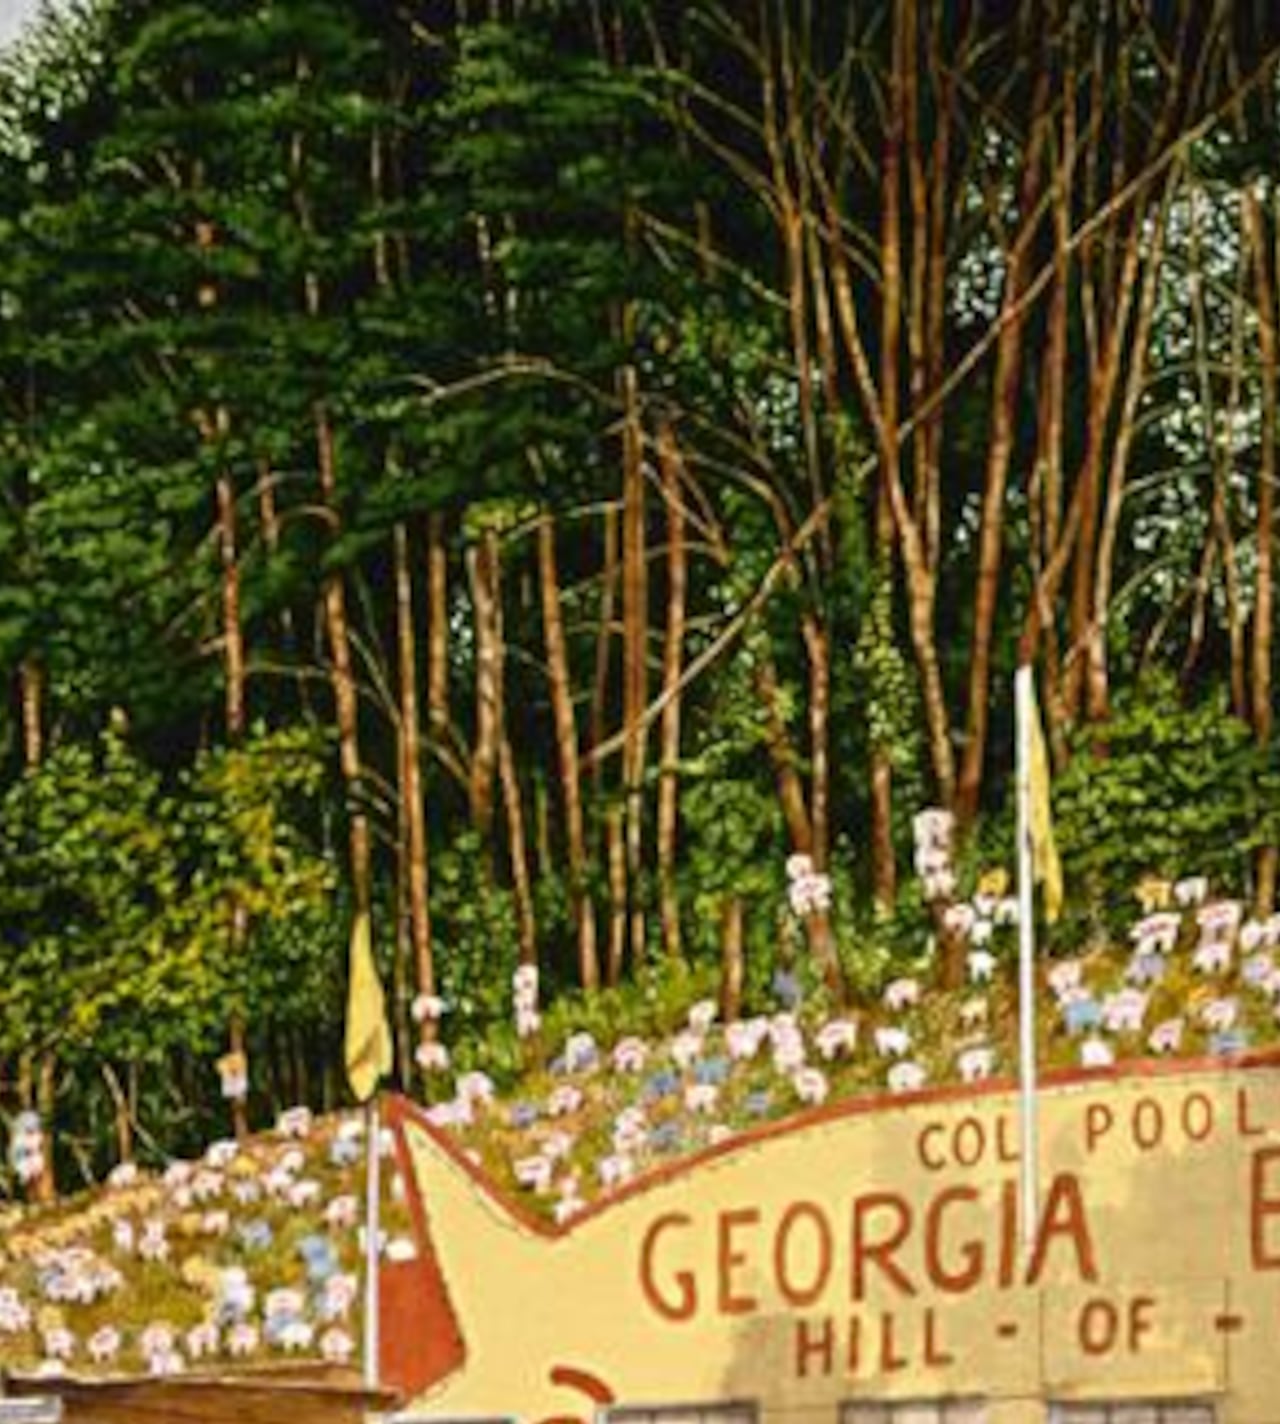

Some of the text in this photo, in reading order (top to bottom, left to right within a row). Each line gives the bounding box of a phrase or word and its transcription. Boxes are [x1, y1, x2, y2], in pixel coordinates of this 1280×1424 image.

[639, 1173, 1098, 1323] GEORGIA
[795, 1308, 954, 1378] HILL
[1078, 1296, 1156, 1355] OF
